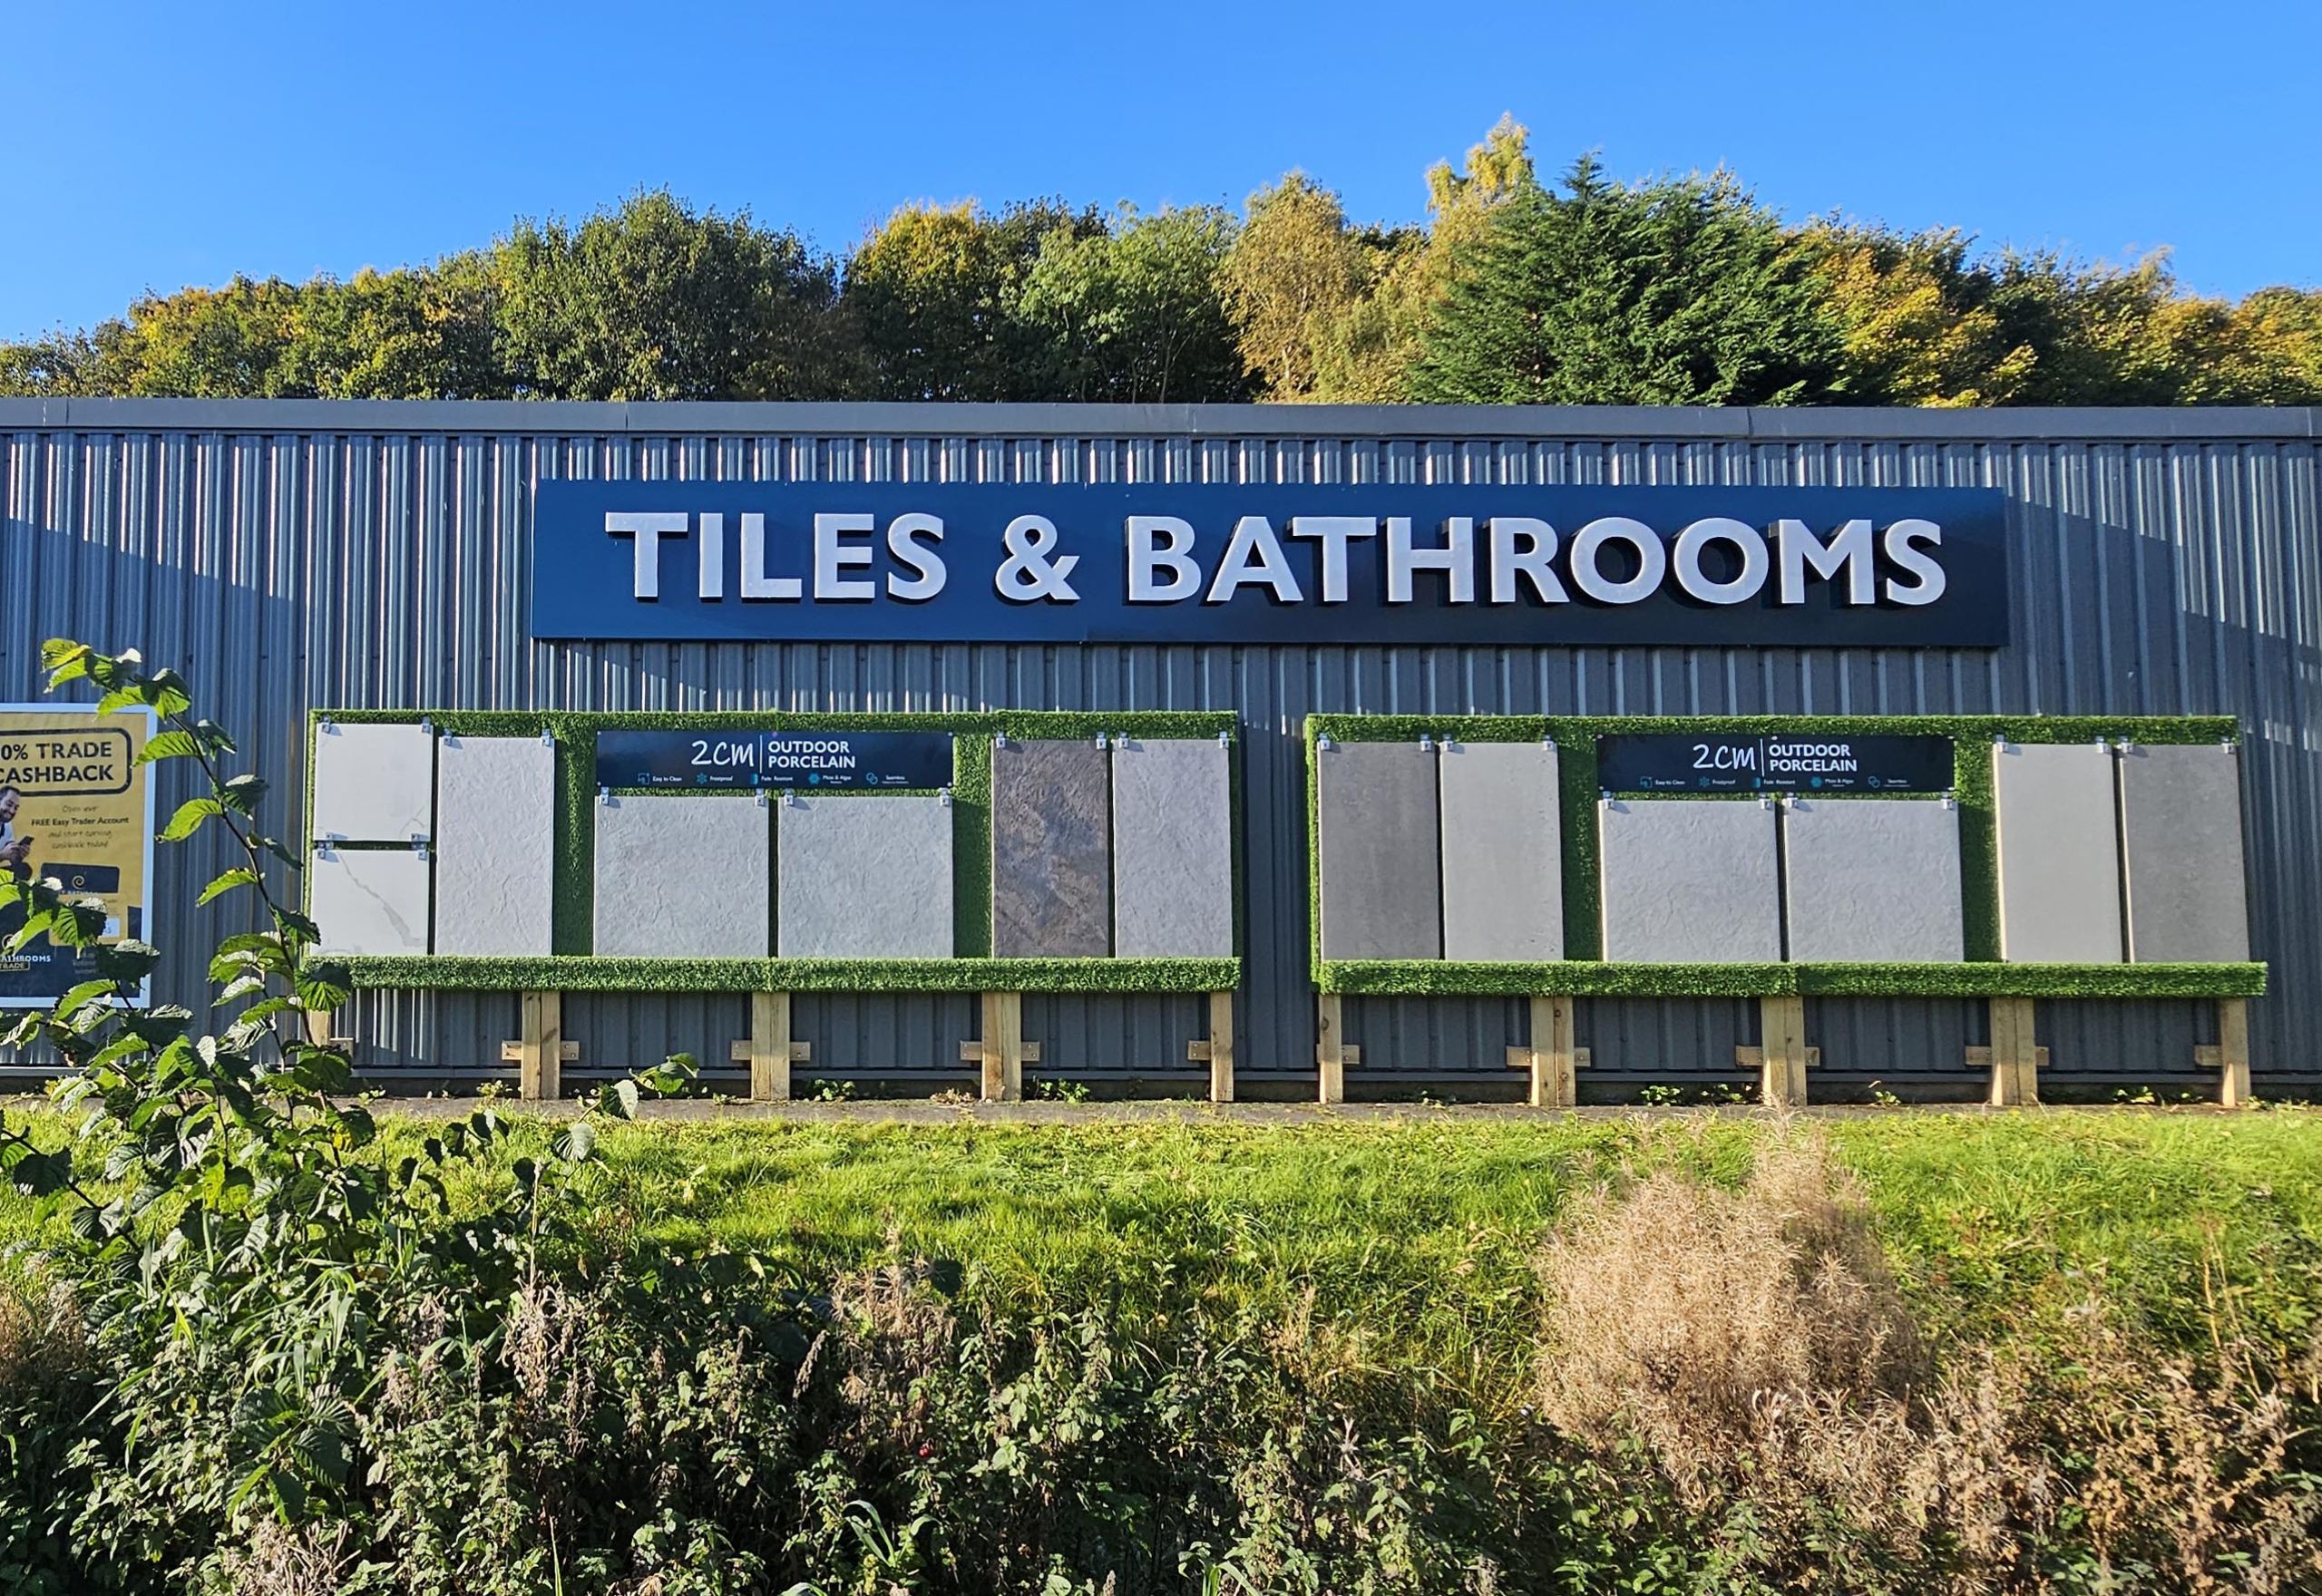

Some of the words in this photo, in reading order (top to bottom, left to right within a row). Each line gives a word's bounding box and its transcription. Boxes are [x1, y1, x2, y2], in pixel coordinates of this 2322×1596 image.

[605, 511, 948, 600] TILES
[995, 514, 1080, 601] &
[1127, 515, 1946, 607] BATHROOMS
[36, 741, 112, 759] TRADE
[691, 740, 755, 767] 2CM
[767, 741, 850, 754] OUTDOOR
[1769, 744, 1851, 757] OUTDOOR
[768, 755, 855, 768] PORCELAIN
[1693, 744, 1756, 770] 2CM
[1770, 759, 1858, 772] PORCELAIN
[52, 818, 69, 827] Easy
